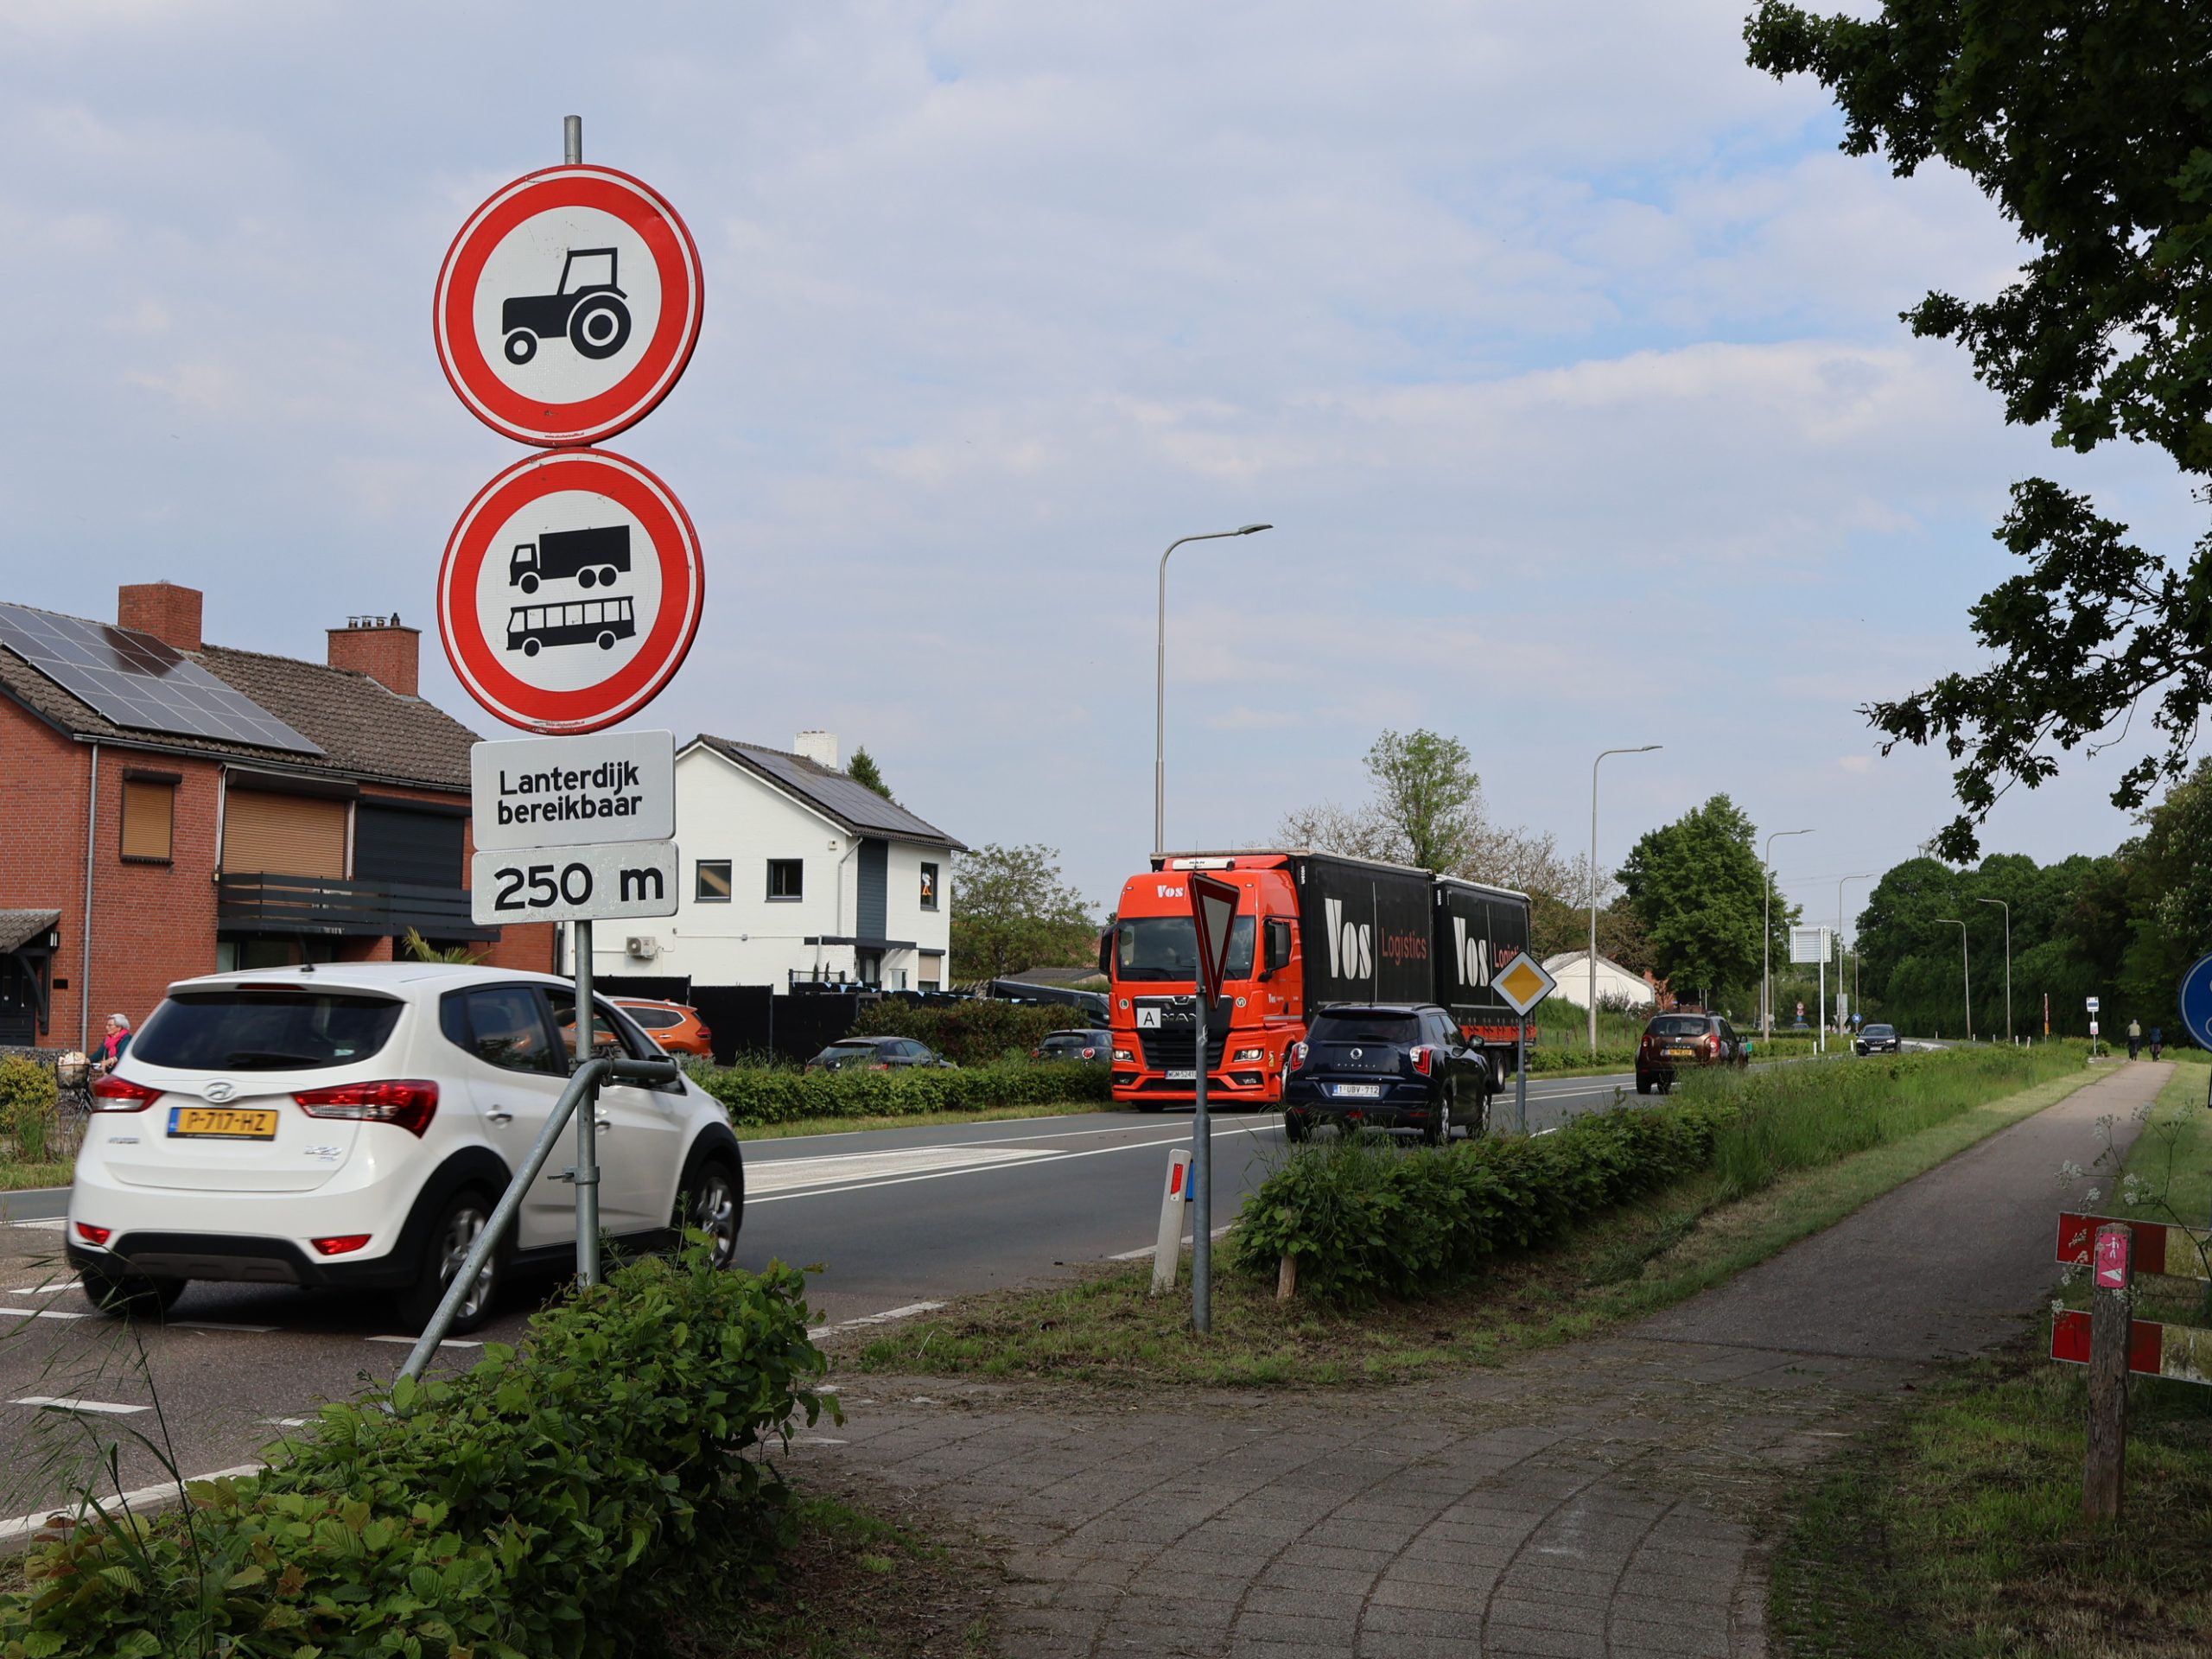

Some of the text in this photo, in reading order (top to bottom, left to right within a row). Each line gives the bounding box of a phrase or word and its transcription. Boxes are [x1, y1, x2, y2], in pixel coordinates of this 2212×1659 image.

[499, 760, 640, 797] Lanterdijk
[498, 793, 643, 825] bereikbaar
[493, 862, 664, 912] 250 m
[1156, 885, 1184, 899] Vos
[1325, 898, 1427, 981] Vos Logistics
[1453, 916, 1489, 988] Vos
[1143, 1011, 1154, 1026] A
[186, 1111, 267, 1132] P-717-HZ
